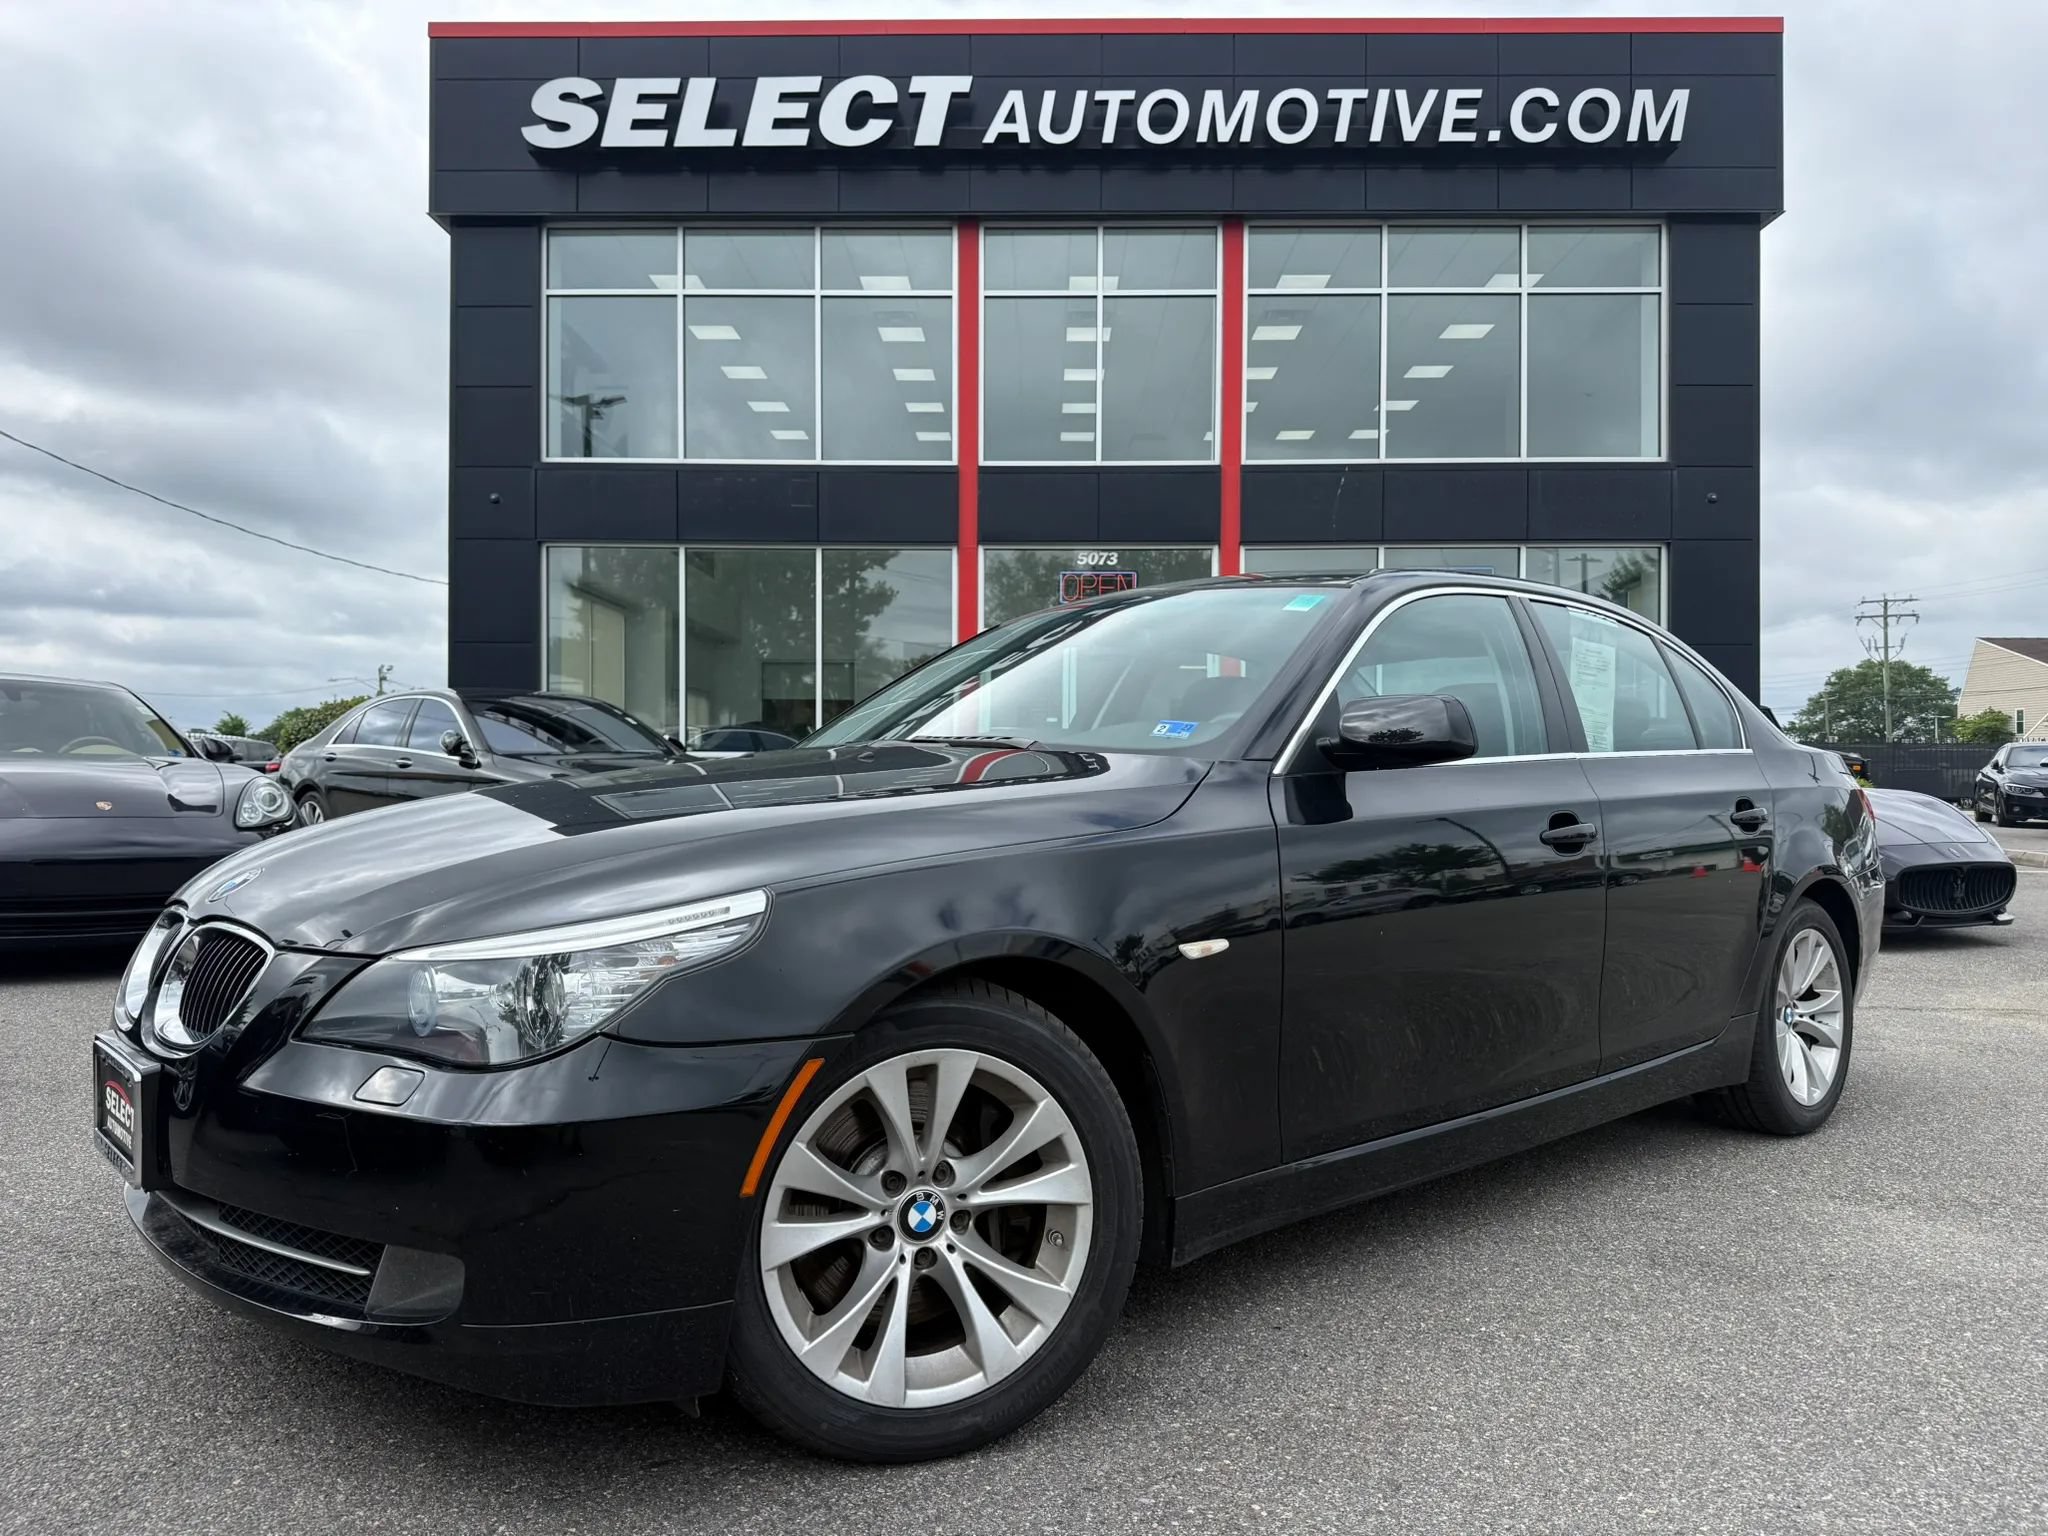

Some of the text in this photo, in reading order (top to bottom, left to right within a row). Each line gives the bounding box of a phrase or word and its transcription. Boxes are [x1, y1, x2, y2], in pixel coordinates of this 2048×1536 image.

[520, 74, 1691, 149] SELECT AUTOMOTIVE.COM
[1076, 551, 1119, 566] 5073
[1062, 574, 1131, 601] OPEN
[105, 1086, 134, 1132] SELECT
[107, 1114, 132, 1150] AUTOMOTIVE
[915, 1191, 944, 1220] BMW
